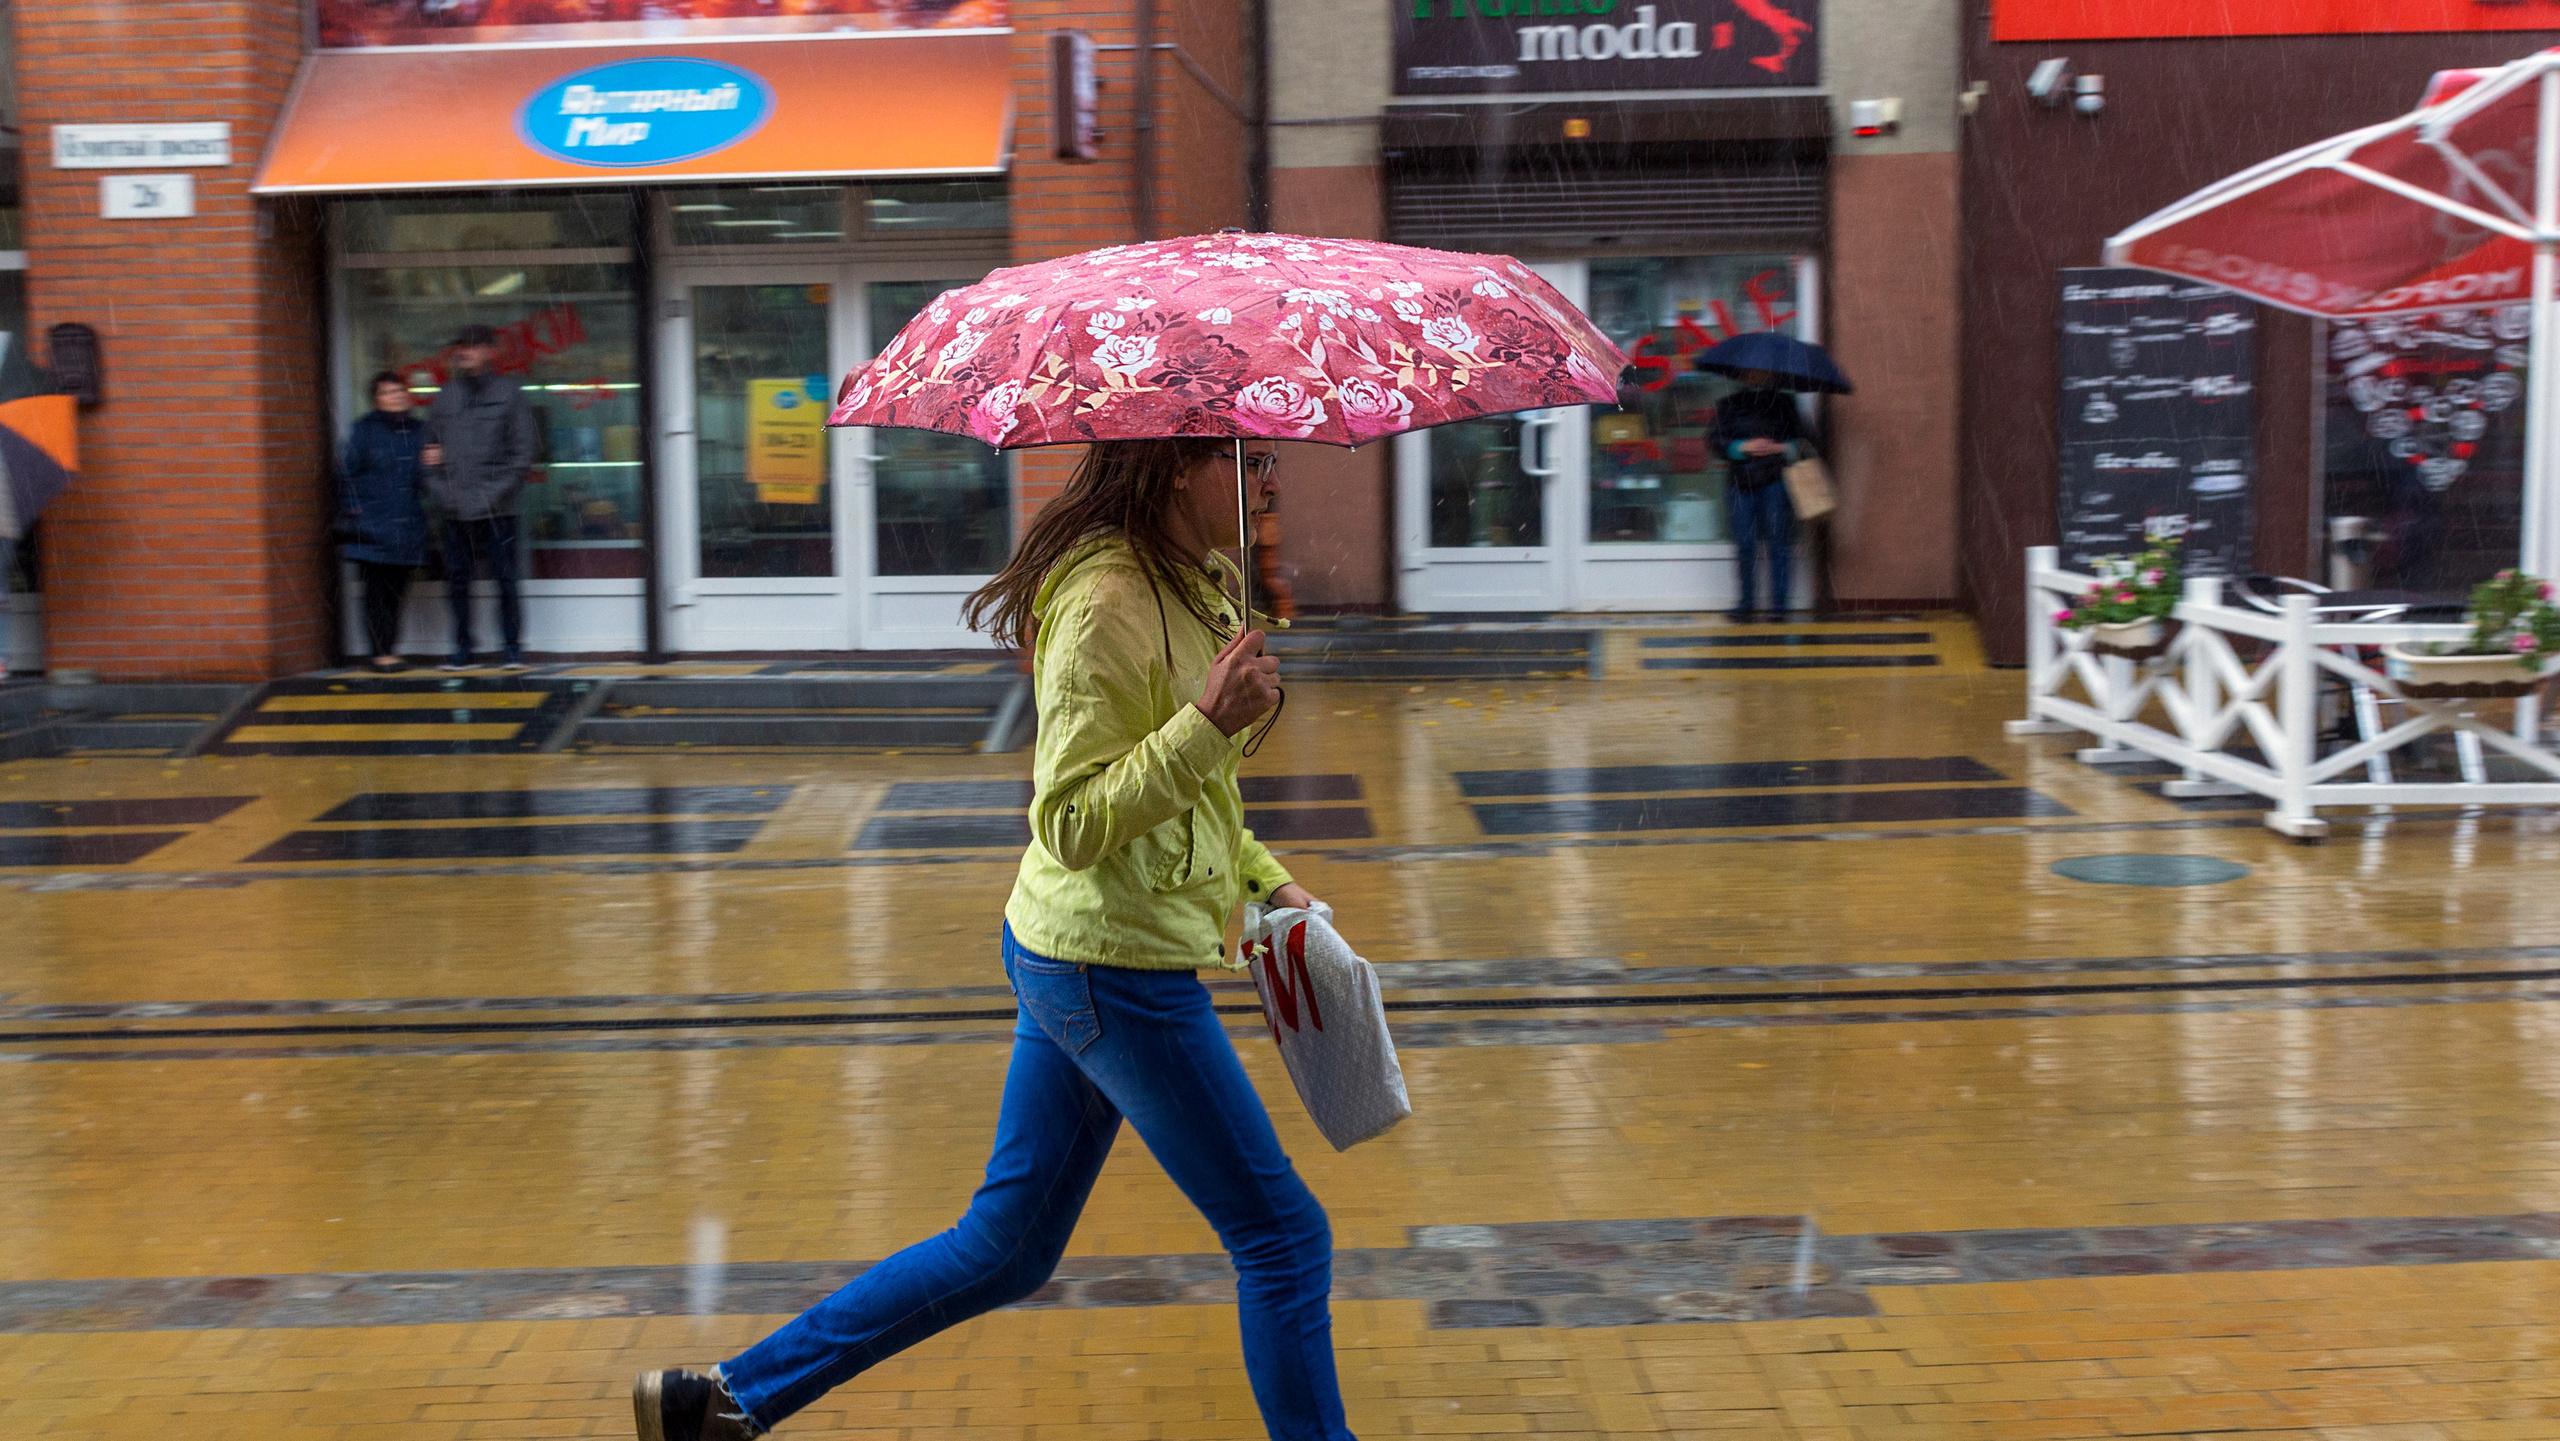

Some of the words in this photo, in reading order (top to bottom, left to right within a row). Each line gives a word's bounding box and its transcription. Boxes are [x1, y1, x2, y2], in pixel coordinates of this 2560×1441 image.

[1517, 5, 1701, 61] moda
[564, 116, 650, 148] Мир
[1629, 269, 1800, 391] SALE
